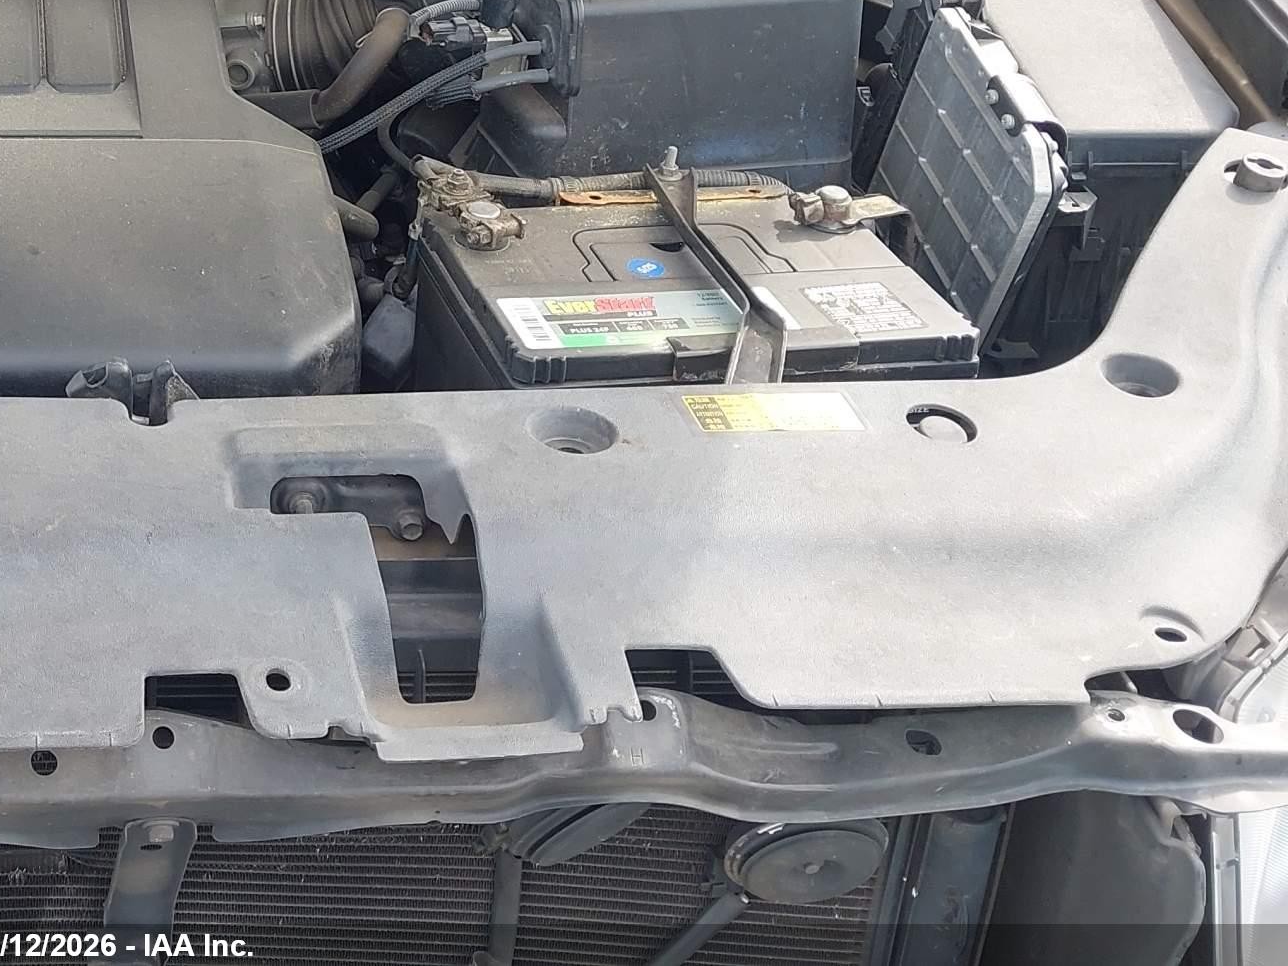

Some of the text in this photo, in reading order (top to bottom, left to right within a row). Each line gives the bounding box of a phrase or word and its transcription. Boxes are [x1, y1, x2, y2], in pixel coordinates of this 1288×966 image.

[544, 295, 656, 315] EverStart
[626, 310, 654, 318] PLUS
[691, 402, 719, 410] CAUTION
